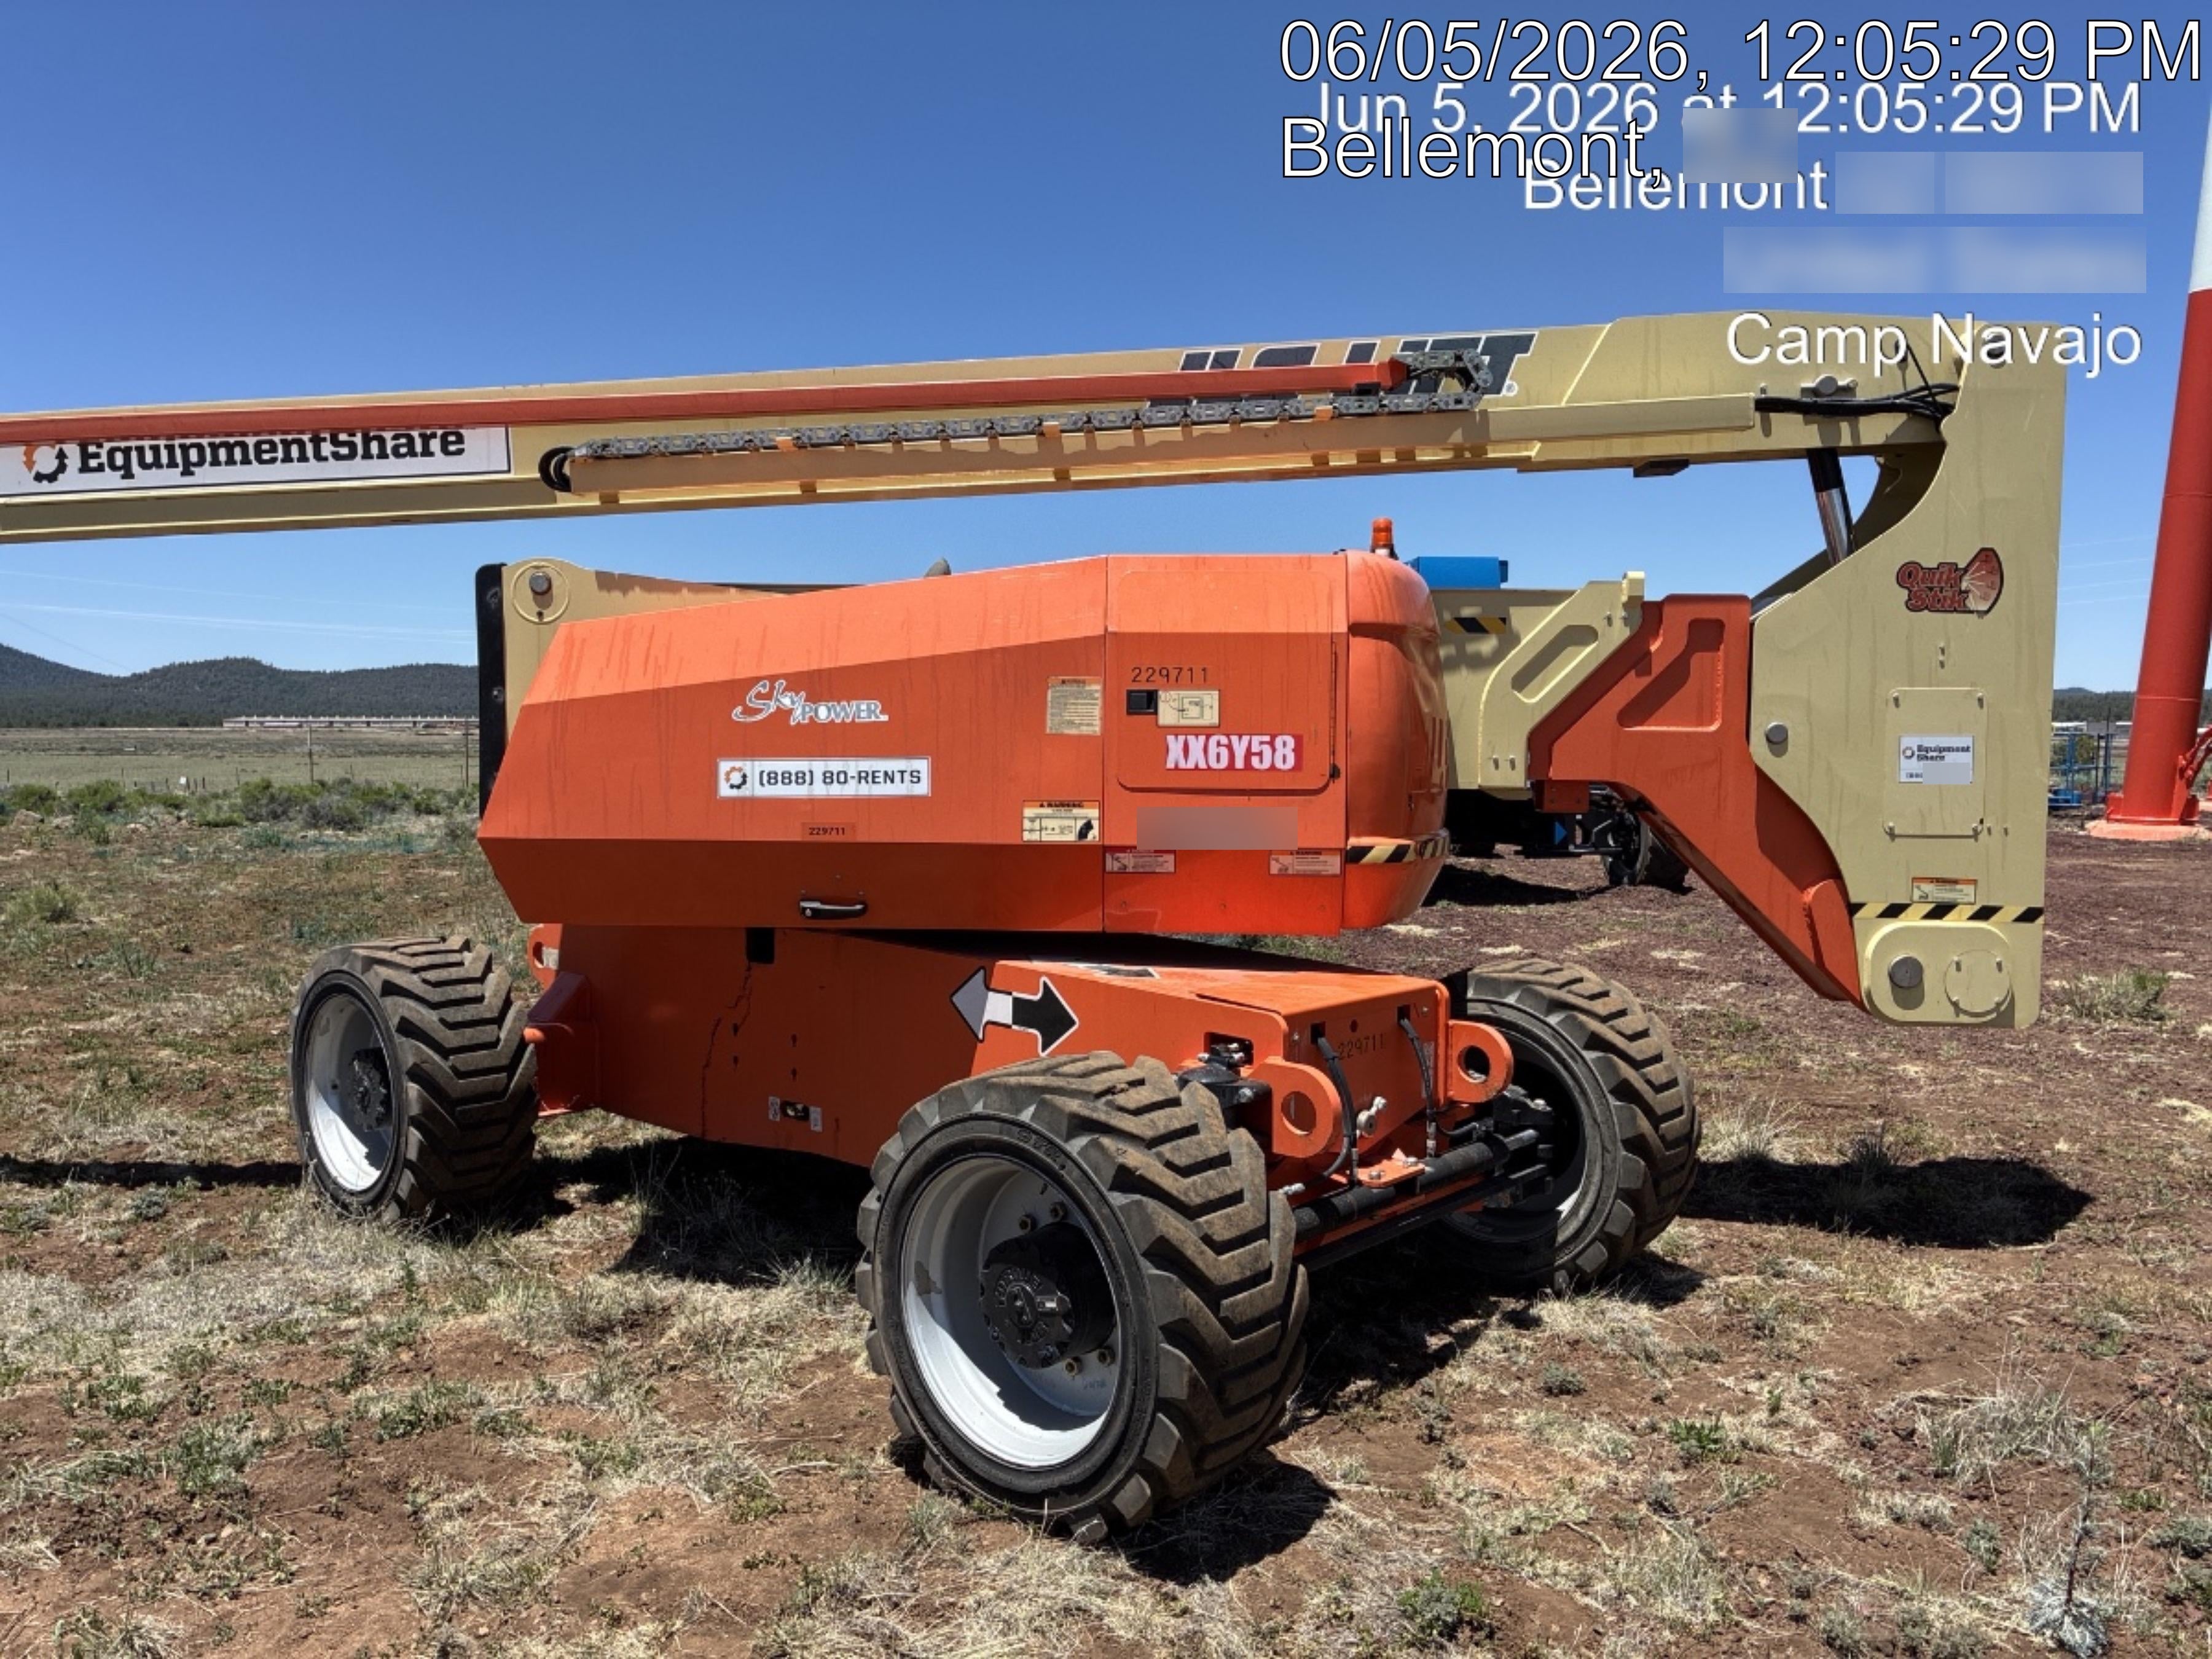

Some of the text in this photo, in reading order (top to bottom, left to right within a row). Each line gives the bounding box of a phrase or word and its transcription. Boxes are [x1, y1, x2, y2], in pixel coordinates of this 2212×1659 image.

[77, 429, 465, 479] EquipmentShare
[1899, 562, 1964, 588] Quik
[1907, 587, 1967, 611] Stik
[1131, 667, 1209, 683] 229711
[1166, 734, 1295, 770] XX6Y58
[1916, 744, 1971, 755] Equipment
[759, 770, 921, 787] (888) 80-RENTS
[809, 826, 845, 836] 229711
